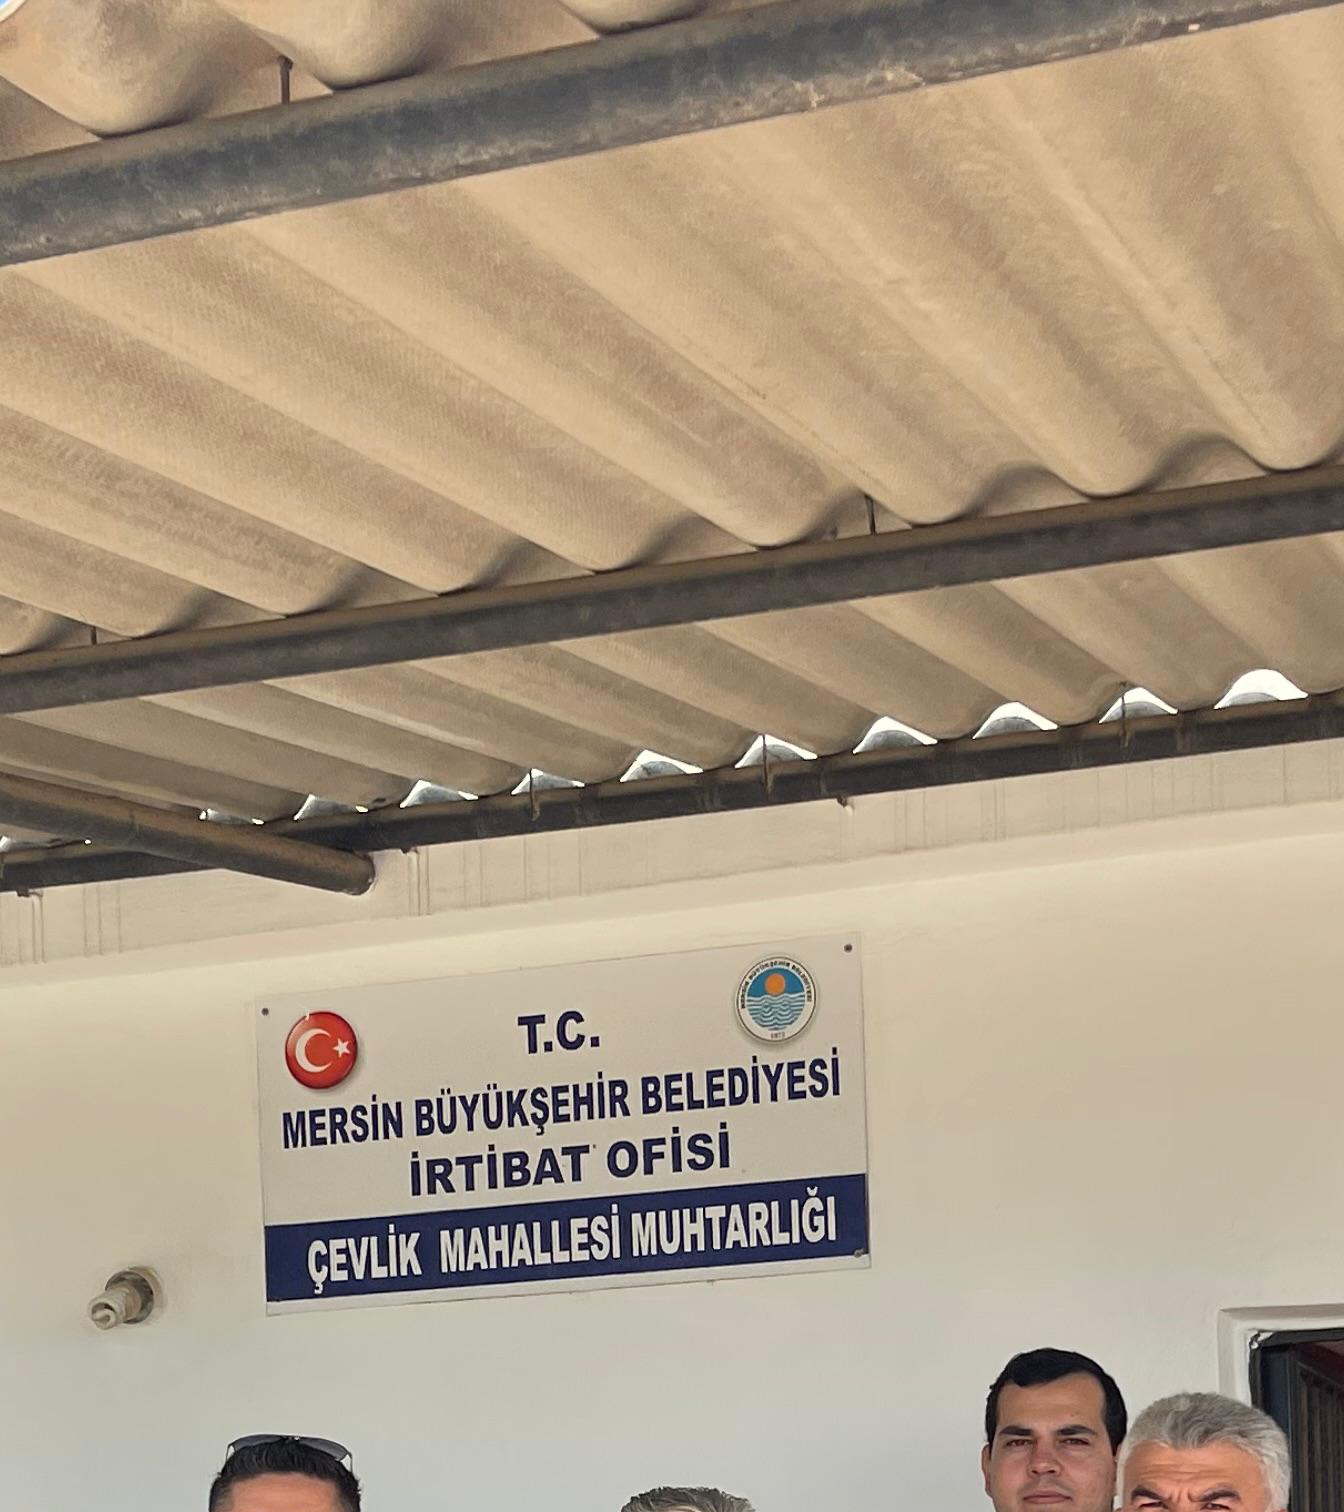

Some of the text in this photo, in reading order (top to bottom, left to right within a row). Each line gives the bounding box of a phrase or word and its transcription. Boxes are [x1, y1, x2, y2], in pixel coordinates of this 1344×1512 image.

[517, 1011, 601, 1055] T.C.
[282, 1047, 841, 1150] MERSİN BÜYÜKŞEHİR BELEDİYESİ
[410, 1121, 731, 1196] İRTİBAT OFİSİ
[307, 1186, 837, 1294] ÇEVLİK MAHALLESİ MUHTARLIĞI
